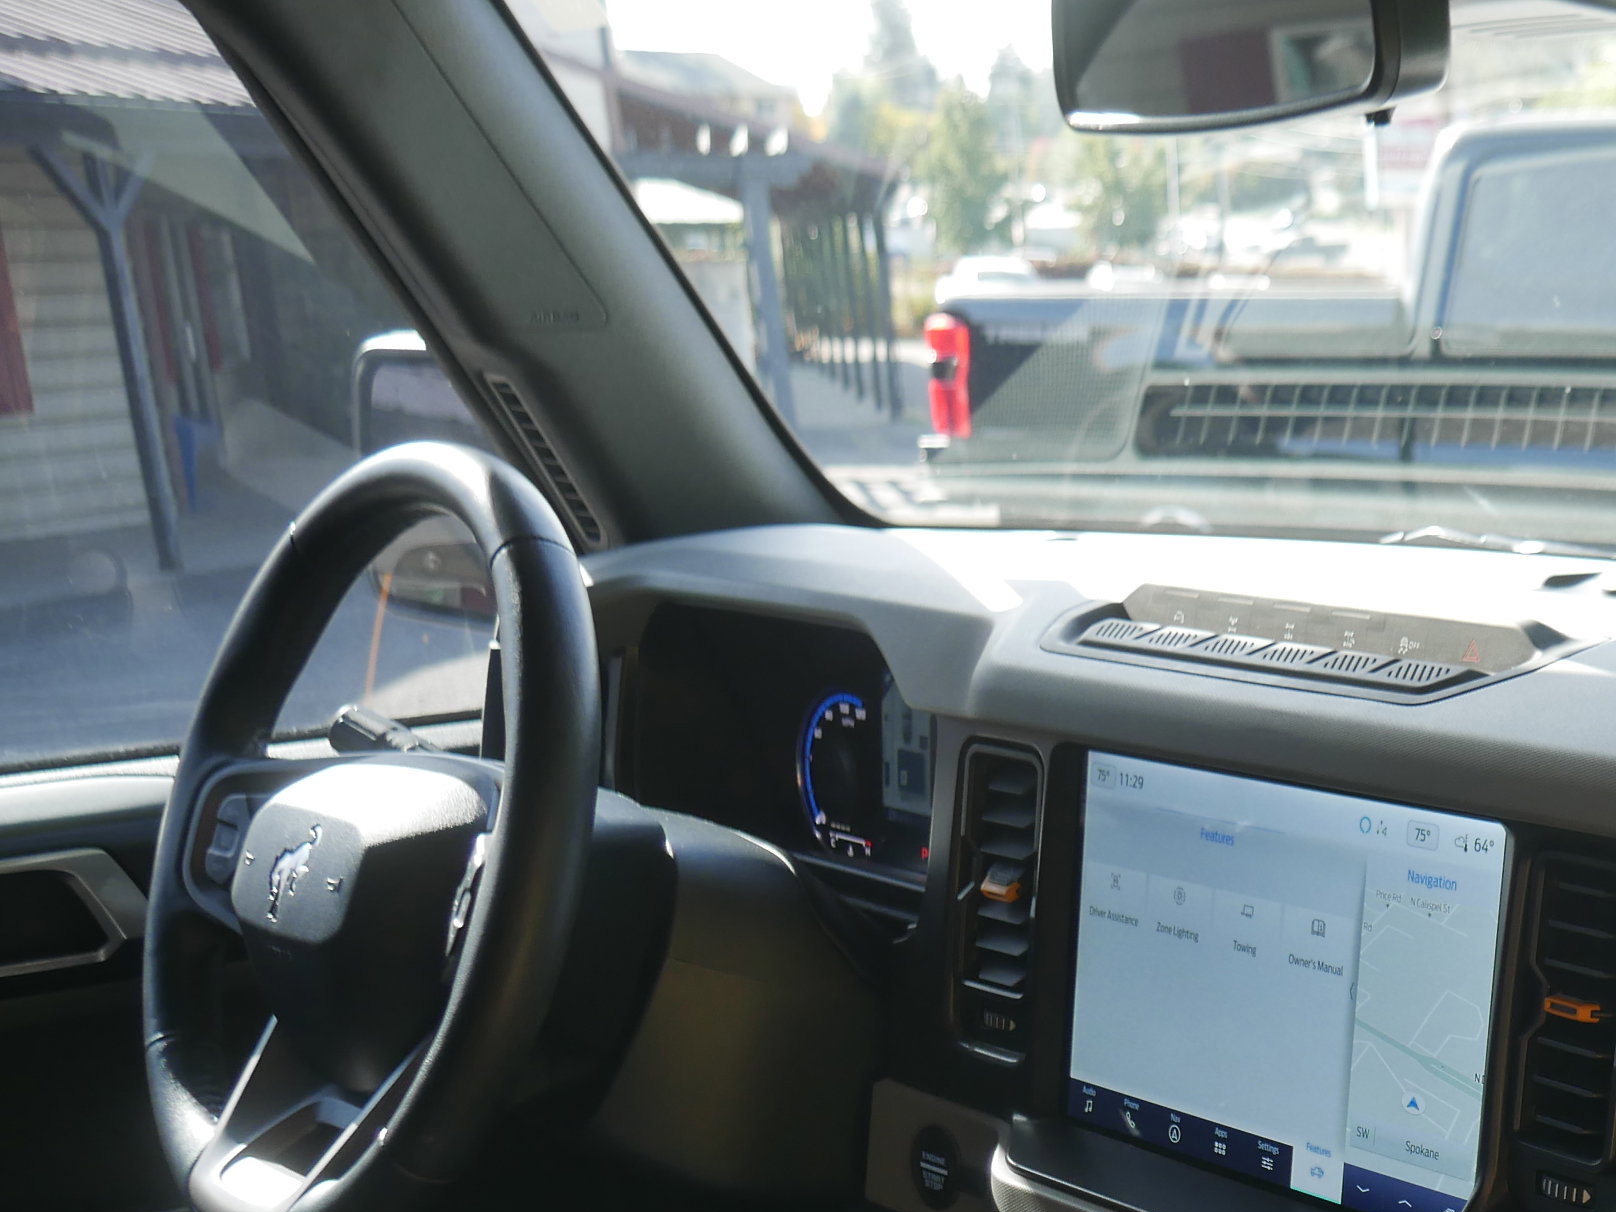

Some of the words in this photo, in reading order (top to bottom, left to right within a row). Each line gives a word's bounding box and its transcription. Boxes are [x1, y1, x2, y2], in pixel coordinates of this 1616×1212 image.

[1119, 772, 1144, 789] 11:29
[1200, 827, 1234, 846] Features
[1473, 837, 1495, 853] 64°
[1407, 869, 1457, 891] Navigation
[1376, 889, 1391, 900] Price
[1392, 894, 1402, 904] Rd
[1089, 905, 1106, 920] Driver
[1106, 909, 1139, 928] Assistance
[1156, 921, 1172, 935] Zone
[1172, 925, 1199, 943] Lighting
[1233, 940, 1257, 958] Towing
[1288, 953, 1317, 972] Owner's
[1317, 961, 1344, 977] Manual
[1083, 1085, 1096, 1097] Audio
[1124, 1098, 1140, 1111] Phone
[1171, 1113, 1181, 1124] Nav
[1214, 1127, 1228, 1140] Apps
[1257, 1140, 1280, 1156] Settings
[1306, 1141, 1332, 1158] Features
[1356, 1126, 1370, 1139] SW
[1405, 1140, 1440, 1160] Spokane
